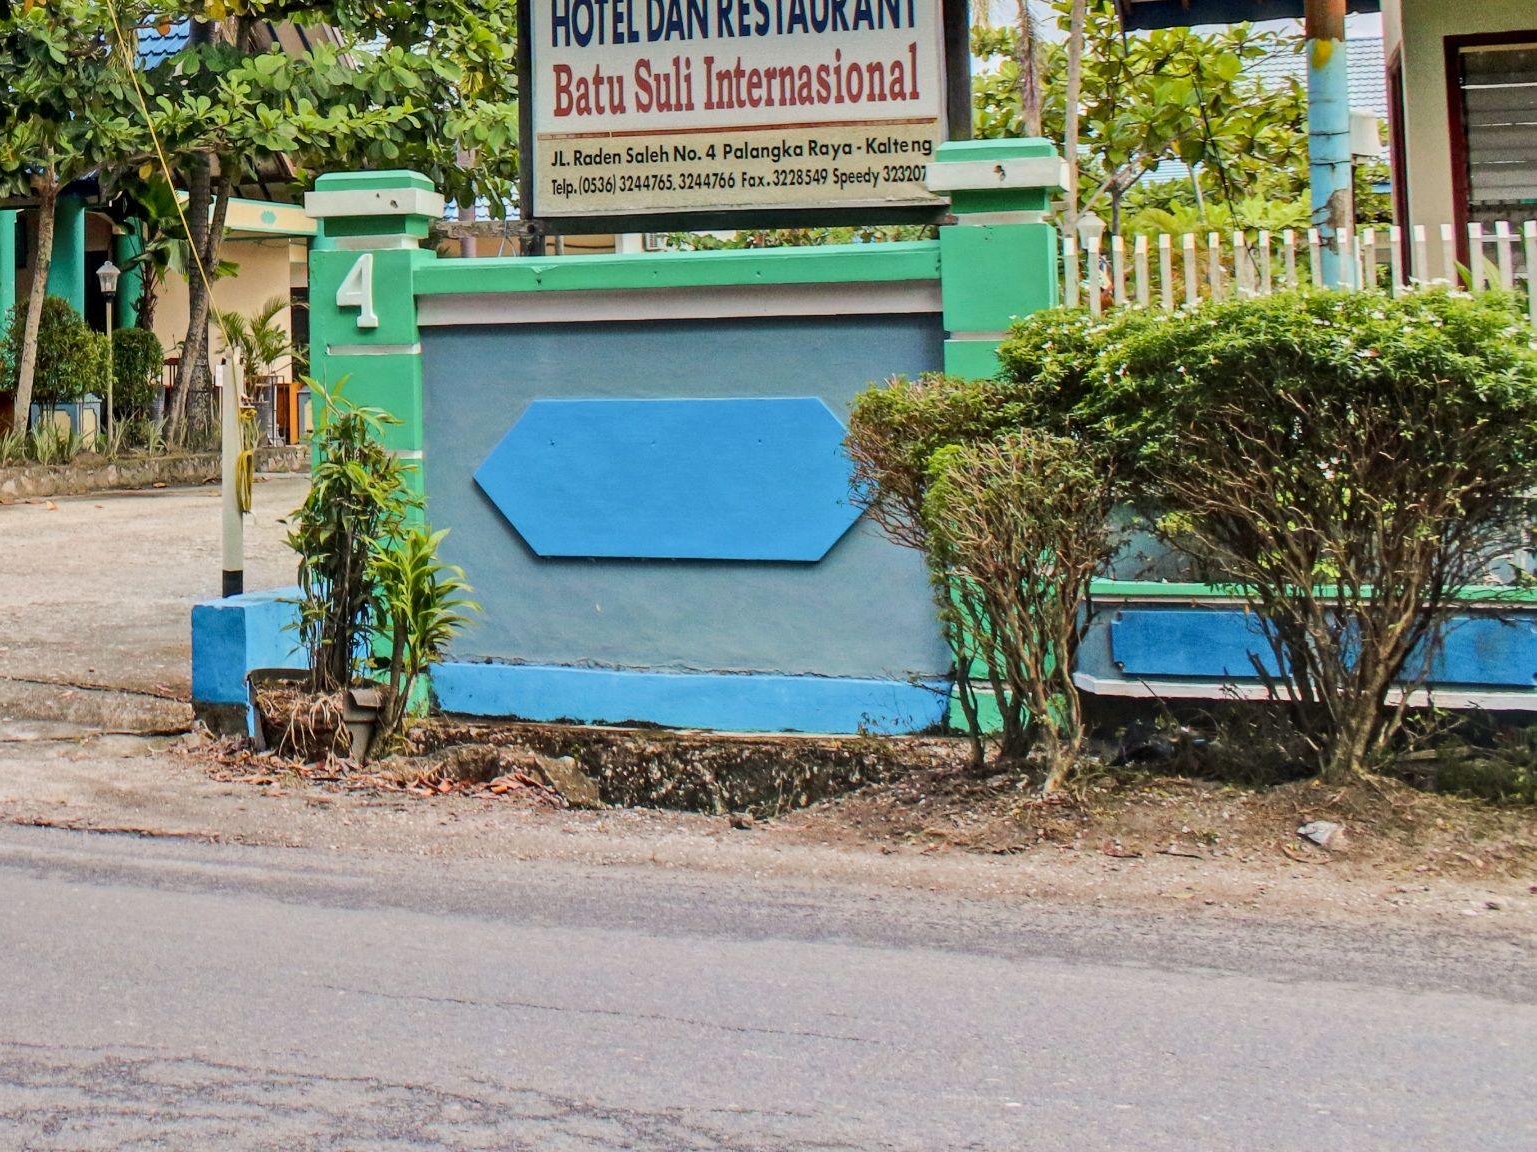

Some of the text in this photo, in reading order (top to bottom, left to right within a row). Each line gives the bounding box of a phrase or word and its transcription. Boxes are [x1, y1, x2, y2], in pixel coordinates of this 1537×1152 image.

[553, 42, 920, 117] Batu Suli Internasional
[551, 151, 570, 167] JL.
[574, 148, 622, 166] Raden
[626, 145, 669, 164] Saleh
[673, 146, 702, 162] No.
[706, 145, 716, 160] 4
[723, 140, 803, 163] Palangka
[808, 140, 853, 160] Raya
[866, 137, 932, 156] Kalteng
[678, 172, 735, 189] 3244766
[833, 167, 880, 189] Speedy
[336, 253, 379, 328] 4
